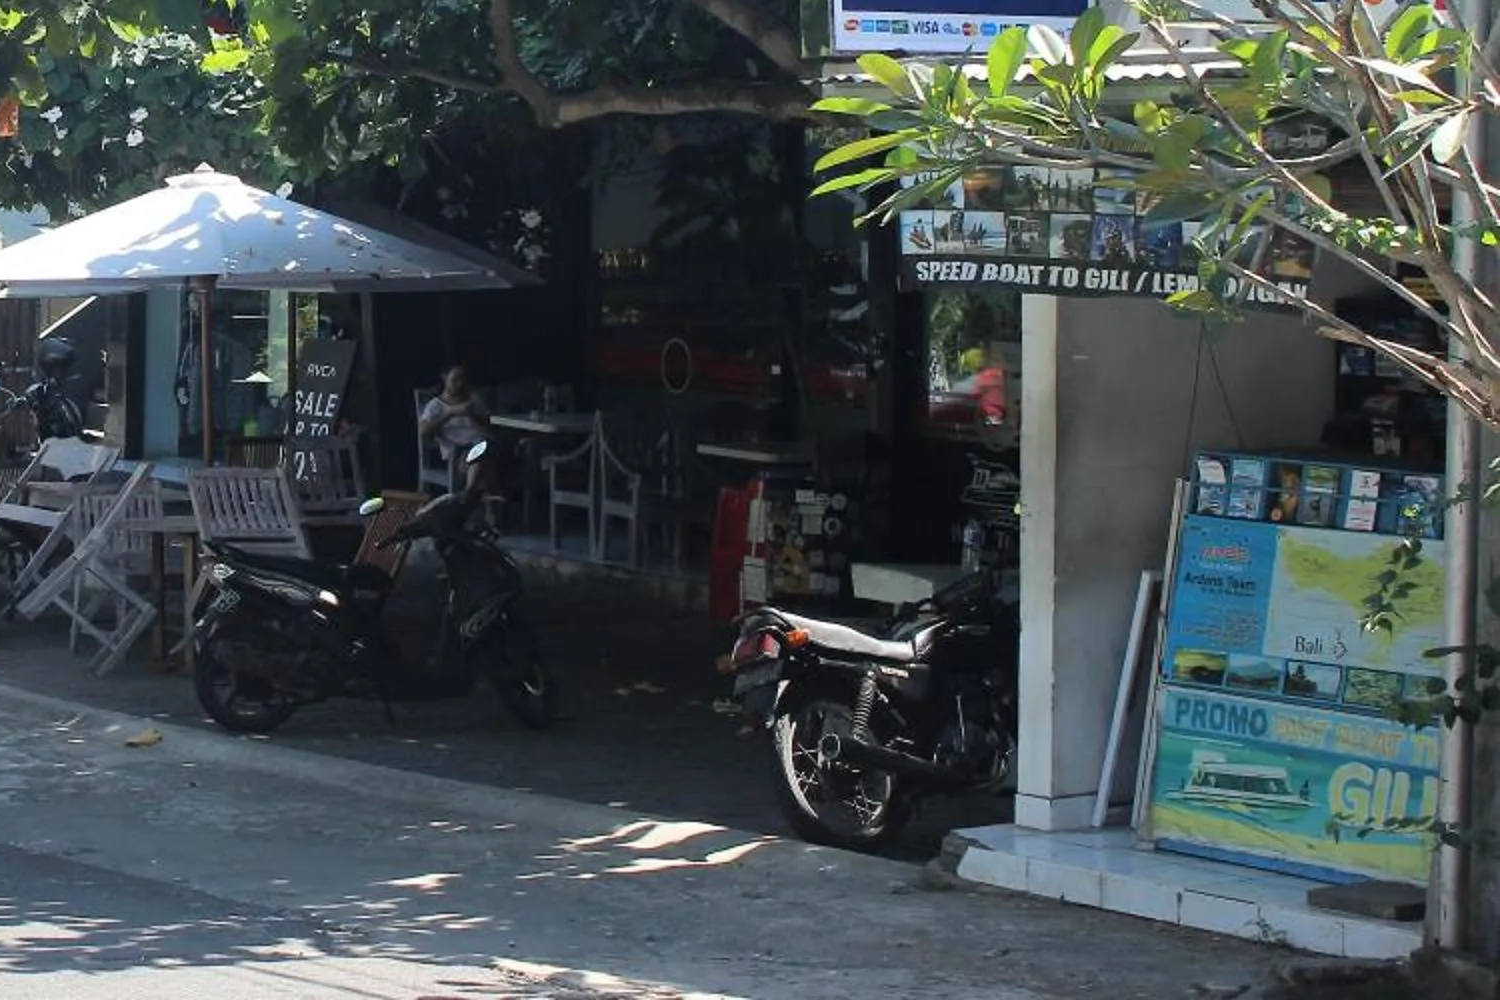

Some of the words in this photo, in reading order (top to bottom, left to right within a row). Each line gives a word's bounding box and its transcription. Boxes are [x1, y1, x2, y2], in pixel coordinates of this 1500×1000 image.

[912, 21, 939, 35] VISA
[915, 261, 978, 281] SPEED
[981, 263, 1044, 285] BOAT
[1048, 266, 1079, 287] TO
[295, 389, 339, 417] SALE
[1294, 635, 1323, 654] Bali
[1175, 697, 1268, 738] PROMO
